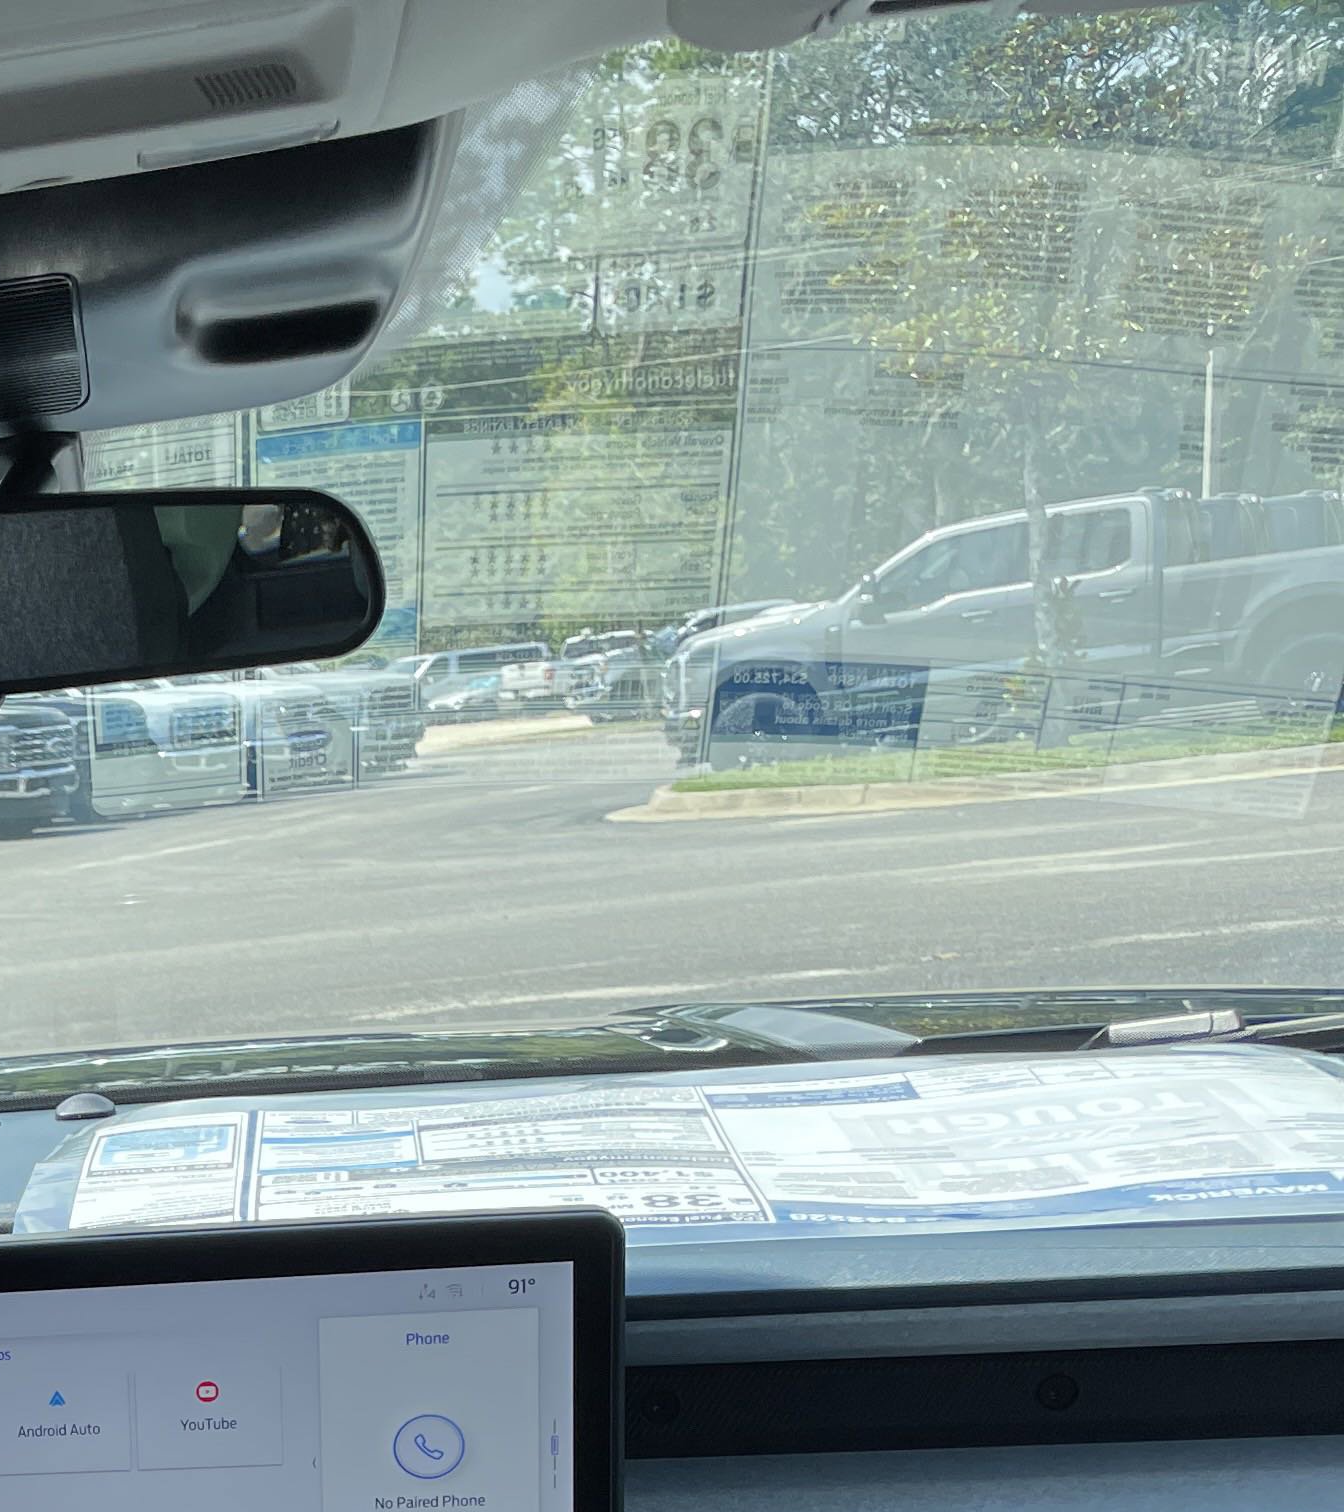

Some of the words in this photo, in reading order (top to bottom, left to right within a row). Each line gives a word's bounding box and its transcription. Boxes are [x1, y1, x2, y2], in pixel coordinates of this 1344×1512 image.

[889, 1092, 1211, 1135] TOUGH
[1149, 1183, 1330, 1202] MAVERICK
[640, 1194, 724, 1208] 38
[405, 1332, 450, 1346] Phone
[17, 1424, 68, 1439] Android
[69, 1423, 101, 1437] Auto
[179, 1417, 238, 1431] YouTube
[374, 1497, 394, 1510] No
[396, 1495, 439, 1509] Paired
[442, 1494, 486, 1508] Phone
